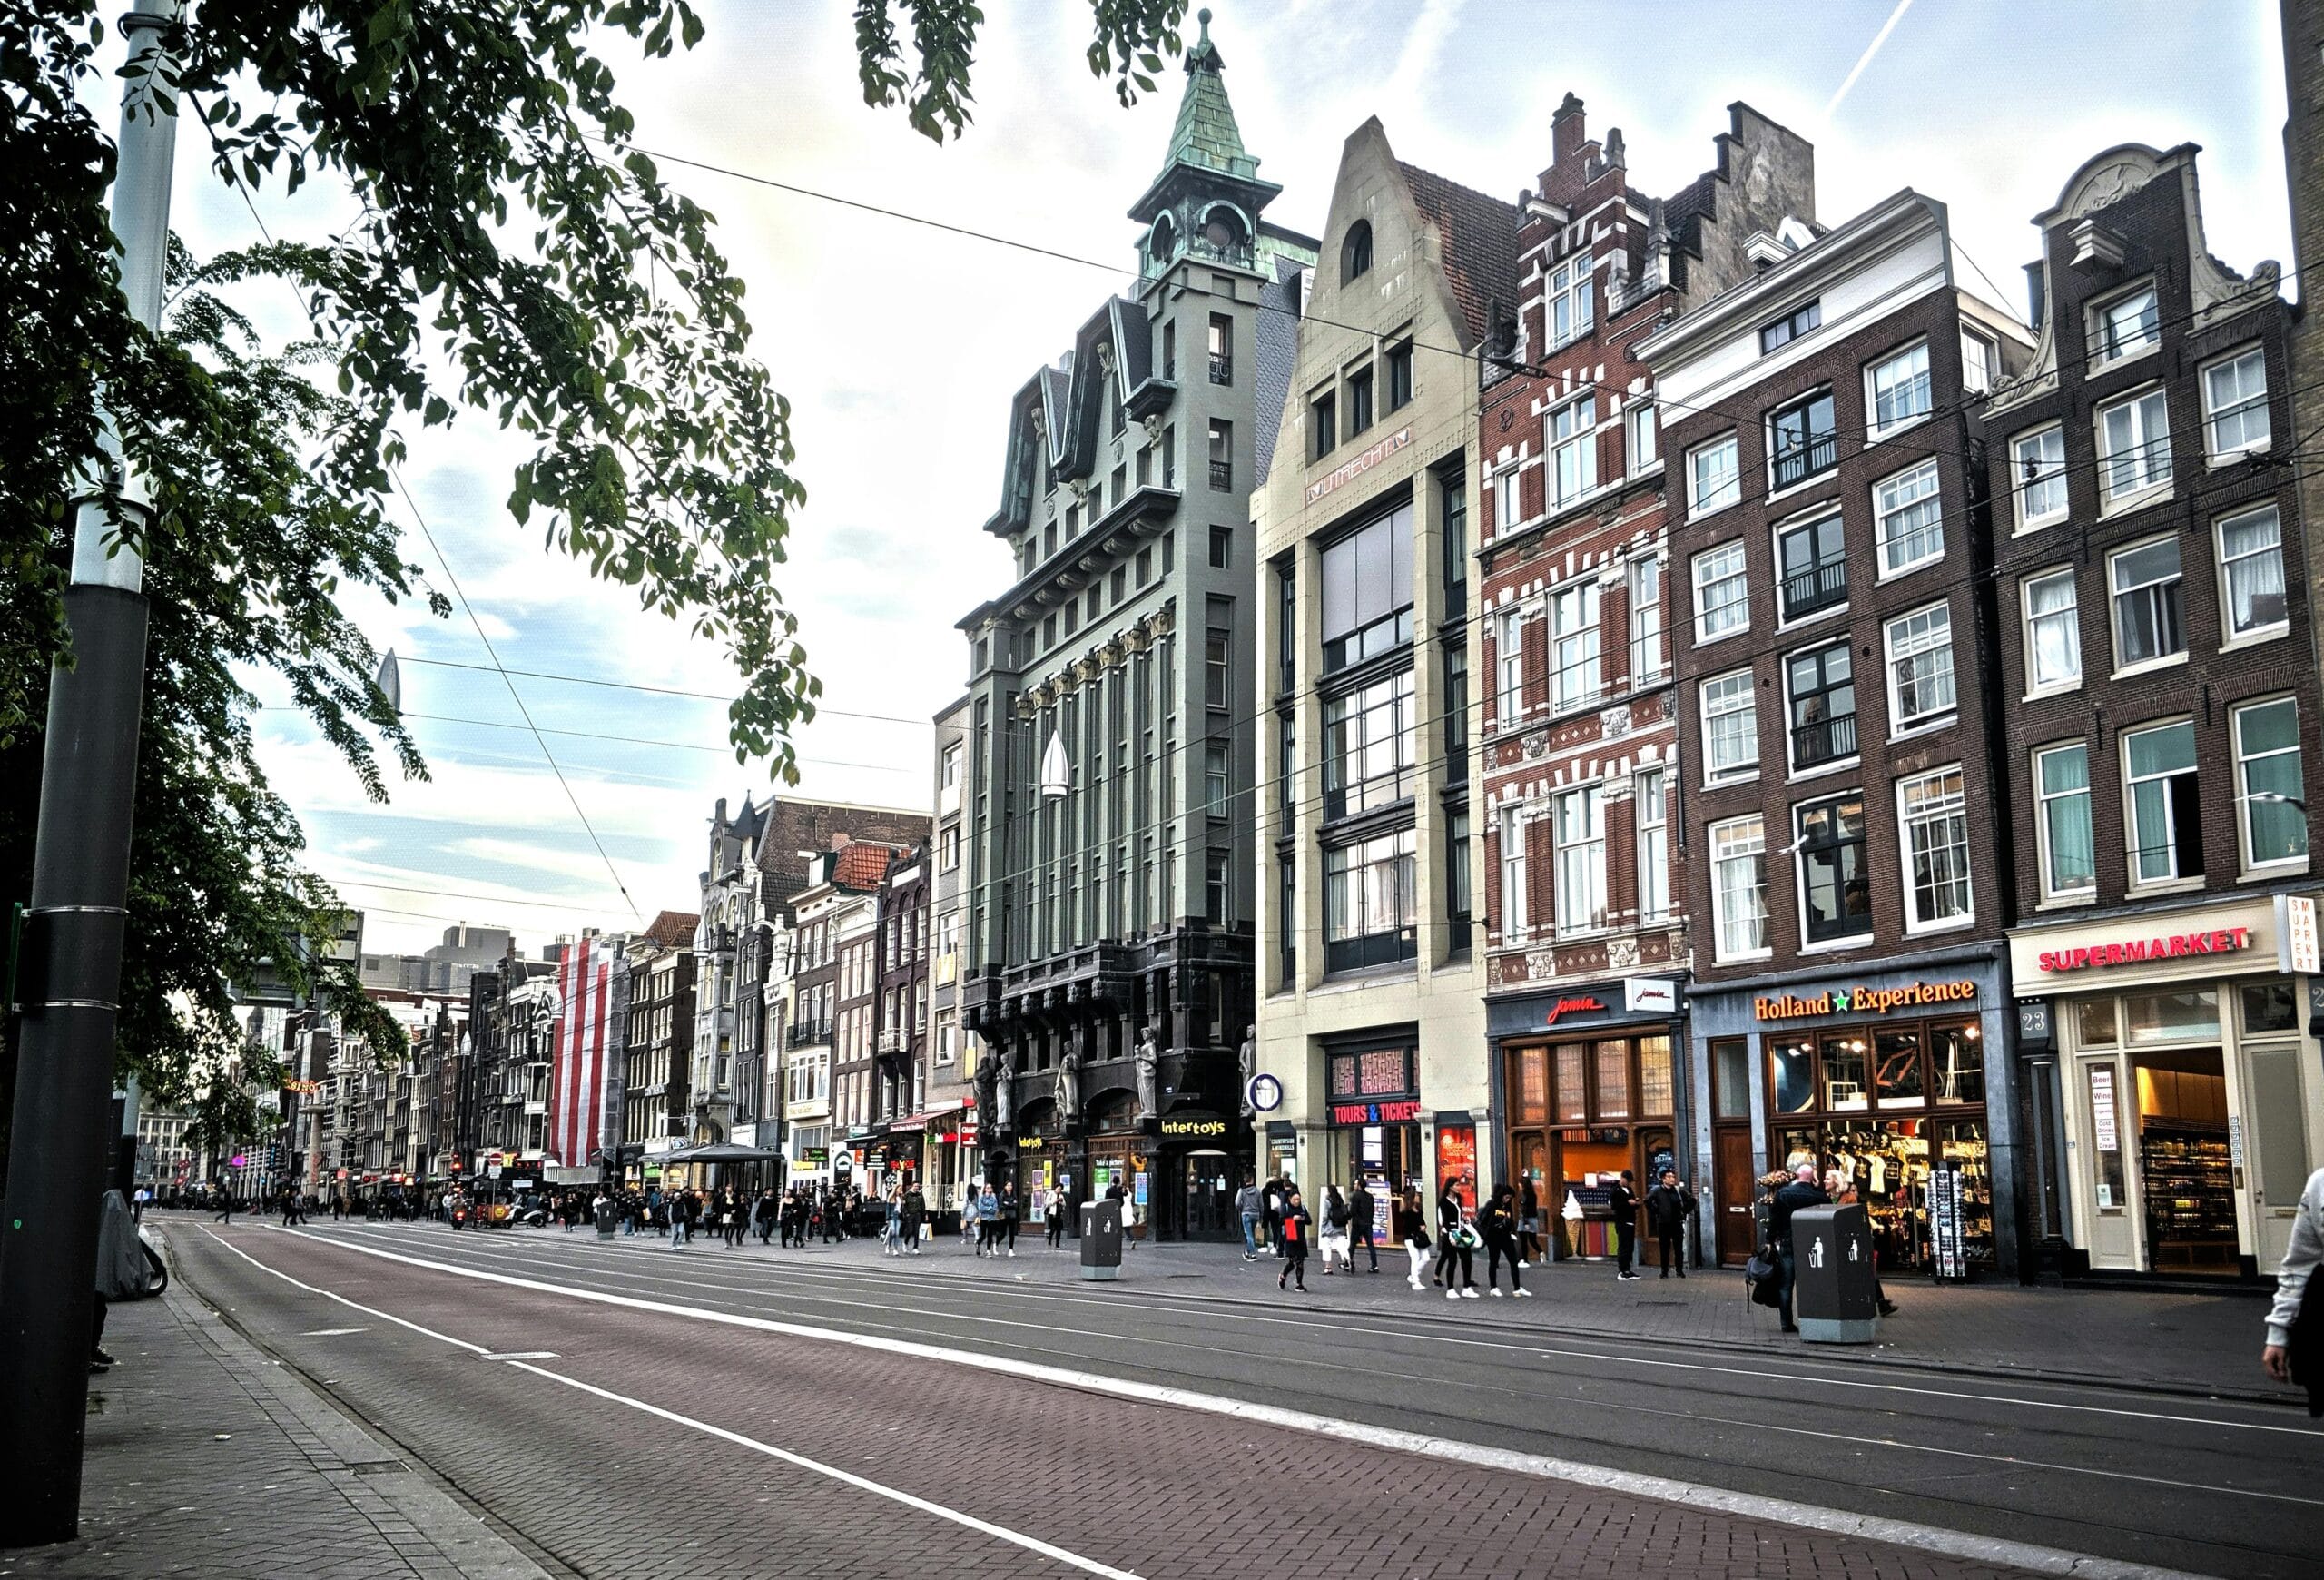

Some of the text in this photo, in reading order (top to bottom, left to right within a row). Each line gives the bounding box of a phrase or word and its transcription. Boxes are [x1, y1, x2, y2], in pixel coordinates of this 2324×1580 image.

[2291, 899, 2303, 969] SUPER
[2301, 901, 2313, 970] MARKT
[2039, 927, 2247, 972] SUPERMARKET
[1547, 995, 1605, 1024] jamin
[1636, 988, 1670, 1002] jamin
[1754, 980, 1974, 1021] Holland Experience
[2022, 1012, 2045, 1031] 23
[1162, 1121, 1226, 1135] Intertoys
[1334, 1104, 1367, 1124] TOURS
[1369, 1103, 1378, 1122] &
